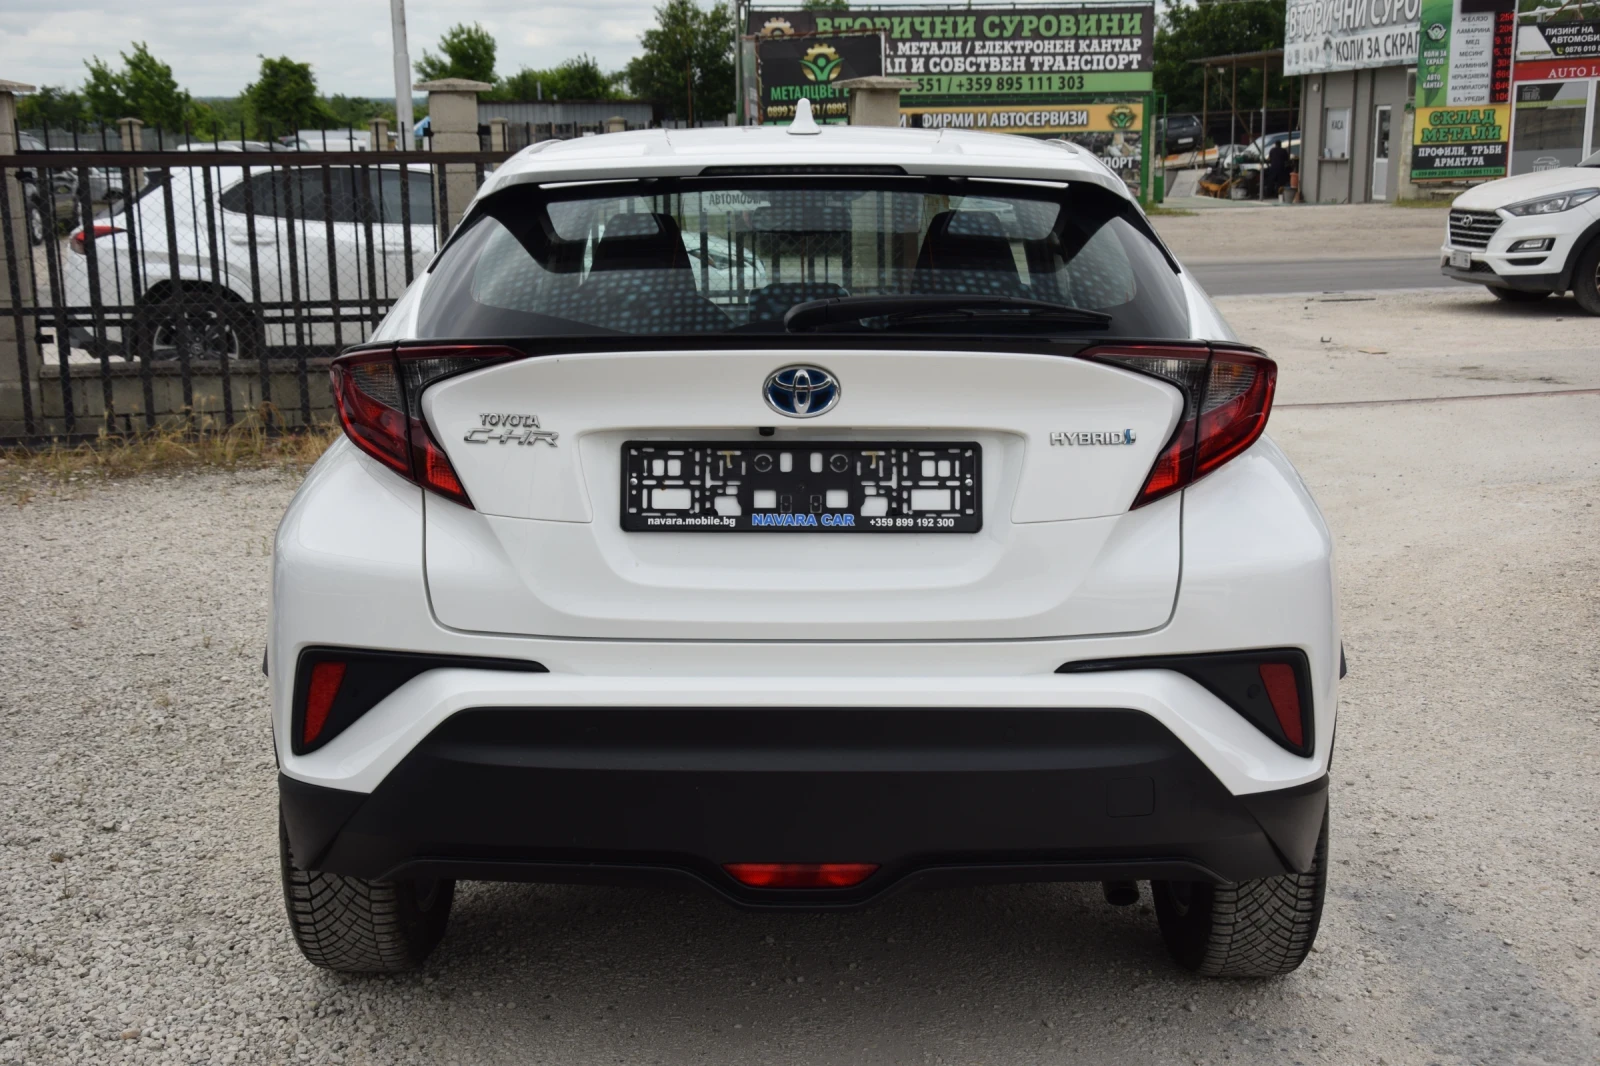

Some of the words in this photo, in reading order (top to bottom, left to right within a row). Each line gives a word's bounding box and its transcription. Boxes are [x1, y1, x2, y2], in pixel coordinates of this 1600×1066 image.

[1370, 0, 1421, 26] СУРО
[1461, 15, 1489, 23] ЖЕЛЯЗО
[983, 13, 1142, 37] СУРОВИНИ
[1456, 27, 1491, 35] ЛАМАРИНА
[1545, 27, 1579, 36] ЛИЗИНГ
[1551, 34, 1600, 44] АВТОМОБИ
[897, 41, 963, 56] МЕТАЛИ
[974, 40, 1075, 55] ЕЛЕКТРОНЕН
[1079, 38, 1142, 53] КАНТАР
[1335, 38, 1364, 62] КОЛИ
[1367, 36, 1381, 59] ЗА
[911, 57, 925, 73] И
[929, 56, 1026, 73] СОБСТВЕН
[1030, 54, 1141, 71] ТРАНСПОРТ
[1548, 67, 1586, 79] AUTO
[1591, 66, 1600, 76] L
[918, 78, 941, 92] 551
[956, 77, 992, 91] +359
[996, 76, 1023, 91] 895
[1028, 76, 1052, 90] 111
[1058, 75, 1085, 90] 303
[767, 106, 788, 117] 0899
[827, 102, 847, 114] 0895
[922, 113, 974, 128] ФИРМИ
[978, 113, 987, 126] И
[990, 111, 1088, 126] АВТОСЕРВИЗИ
[1430, 109, 1496, 126] СКЛАД
[1331, 120, 1344, 130] КАСА
[1421, 126, 1502, 142] МЕТАЛИ
[1418, 147, 1467, 157] ПРОФИЛИ,
[1471, 145, 1502, 155] ТРЪБИ
[1433, 157, 1485, 167] АРМАТУРА
[480, 412, 540, 428] TOYOTA
[464, 427, 559, 447] C-HR
[1050, 432, 1123, 446] HYBRID
[647, 516, 736, 527] navara.mobile.bg
[751, 513, 817, 527] NAVARA
[821, 513, 855, 527] CAR
[869, 518, 893, 527] +359
[895, 518, 914, 527] 899
[916, 518, 934, 527] 192
[936, 518, 955, 527] 300
